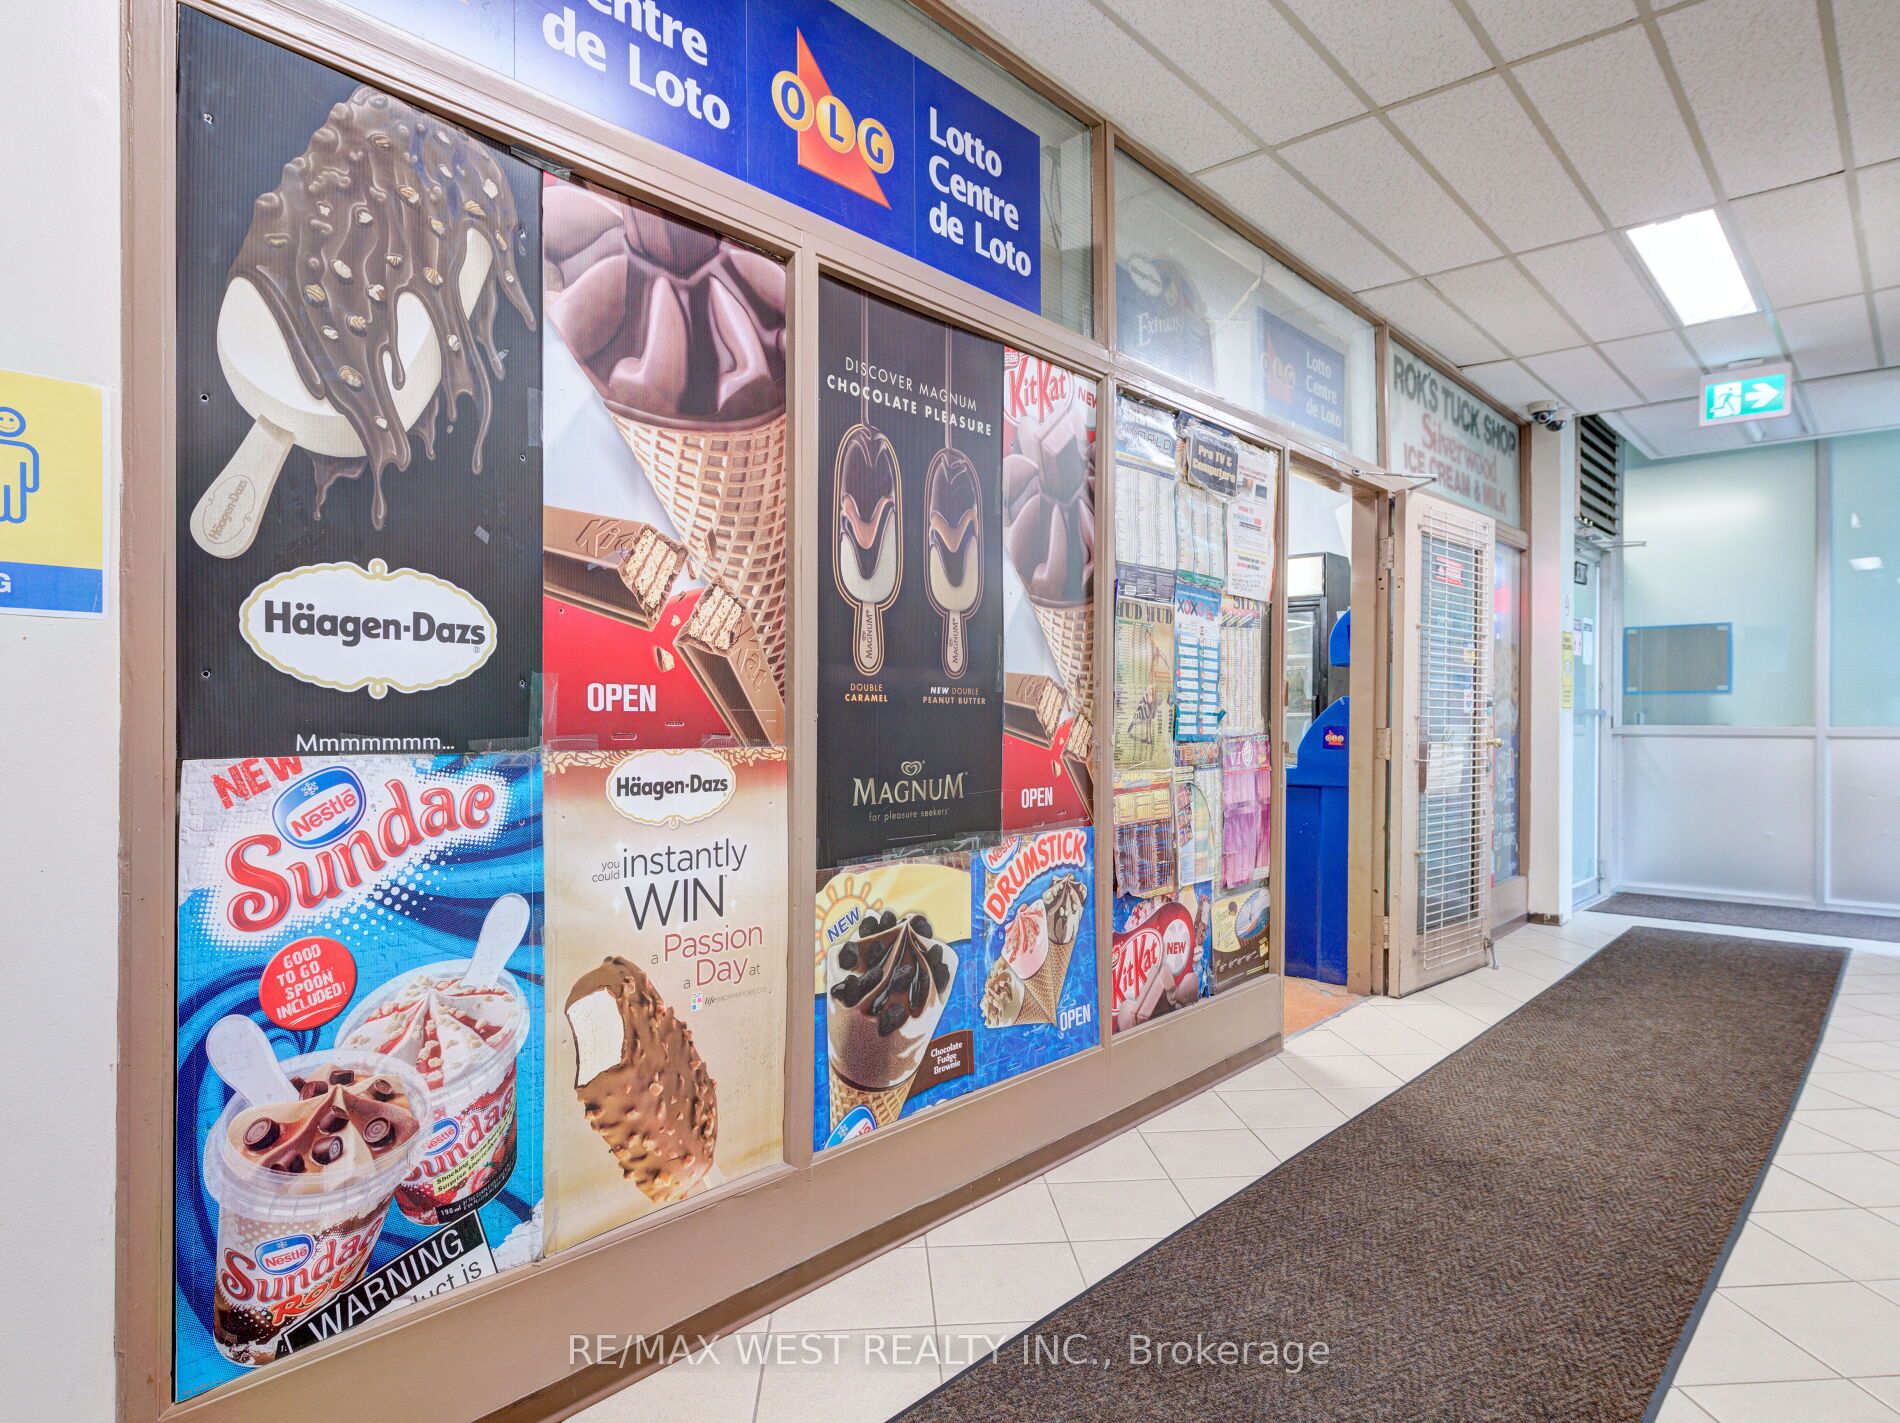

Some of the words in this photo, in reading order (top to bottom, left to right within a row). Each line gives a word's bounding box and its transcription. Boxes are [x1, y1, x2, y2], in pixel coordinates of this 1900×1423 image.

[587, 0, 707, 66] ntre
[542, 6, 607, 72] de
[629, 42, 731, 130] Loto
[773, 72, 893, 172] OLG
[929, 106, 1002, 177] Lotto
[929, 157, 1019, 231] Centre
[929, 206, 964, 247] de
[974, 234, 1031, 278] Loto
[1306, 351, 1332, 379] Lotto
[845, 356, 913, 392] DISCOVER
[919, 384, 977, 411] MAGNUM
[1009, 356, 1066, 424] KitKat
[1306, 375, 1337, 405] Centre
[826, 374, 917, 415] CHOCOLATE
[925, 405, 992, 436] PLEASURE
[1306, 397, 1319, 418] de
[1321, 404, 1342, 429] Loto
[1394, 354, 1438, 413] ROK'S
[1441, 386, 1480, 439] TUCK
[1484, 414, 1516, 458] SHOP
[1215, 451, 1226, 465] TV
[1404, 442, 1426, 474] ICE
[1429, 456, 1471, 498] CREAM
[1483, 481, 1507, 514] MILK
[264, 600, 485, 647] Häagen-Dazs
[587, 682, 656, 712] OPEN
[844, 693, 888, 703] CARAMEL
[850, 683, 883, 692] DOUBLE
[922, 696, 954, 705] PEANUT
[958, 697, 986, 705] BUTTER
[930, 686, 950, 695] NEW
[951, 687, 980, 695] DOUBLE
[210, 756, 303, 810] NEW
[616, 774, 729, 801] Häagen-Dazs
[853, 771, 965, 807] MAGNUM
[1021, 786, 1053, 810] OPEN
[289, 787, 357, 838] Nestlé
[869, 811, 881, 821] for
[884, 810, 918, 823] pleasure
[920, 807, 949, 818] seekers
[225, 778, 495, 932] Sundae
[591, 869, 620, 883] could
[623, 838, 748, 879] instantly
[601, 859, 620, 873] you
[986, 831, 1085, 920] DRUMSTICK
[624, 874, 724, 931] WIN
[827, 906, 860, 944] NEW
[283, 943, 322, 969] GOOD
[650, 953, 660, 965] a
[664, 925, 763, 962] Passion
[1167, 941, 1187, 955] NEW
[276, 970, 297, 987] TO
[285, 971, 334, 1000] SPOON
[683, 978, 691, 990] a
[696, 957, 748, 988] Day
[749, 963, 761, 976] at
[1111, 934, 1158, 1010] KitKat
[276, 981, 347, 1020] INCLUDED!
[1060, 1004, 1091, 1032] OPEN
[930, 1042, 963, 1058] Chocolate
[937, 1053, 957, 1065] Fudge
[933, 1060, 961, 1075] Brownie
[426, 1126, 455, 1150] estlé
[436, 1160, 469, 1185] Shocking
[438, 1170, 467, 1193] Surprise
[221, 1217, 383, 1303] Sundae
[264, 1245, 308, 1268] Nestlé
[308, 1228, 464, 1342] WARNING
[461, 1261, 483, 1285] is
